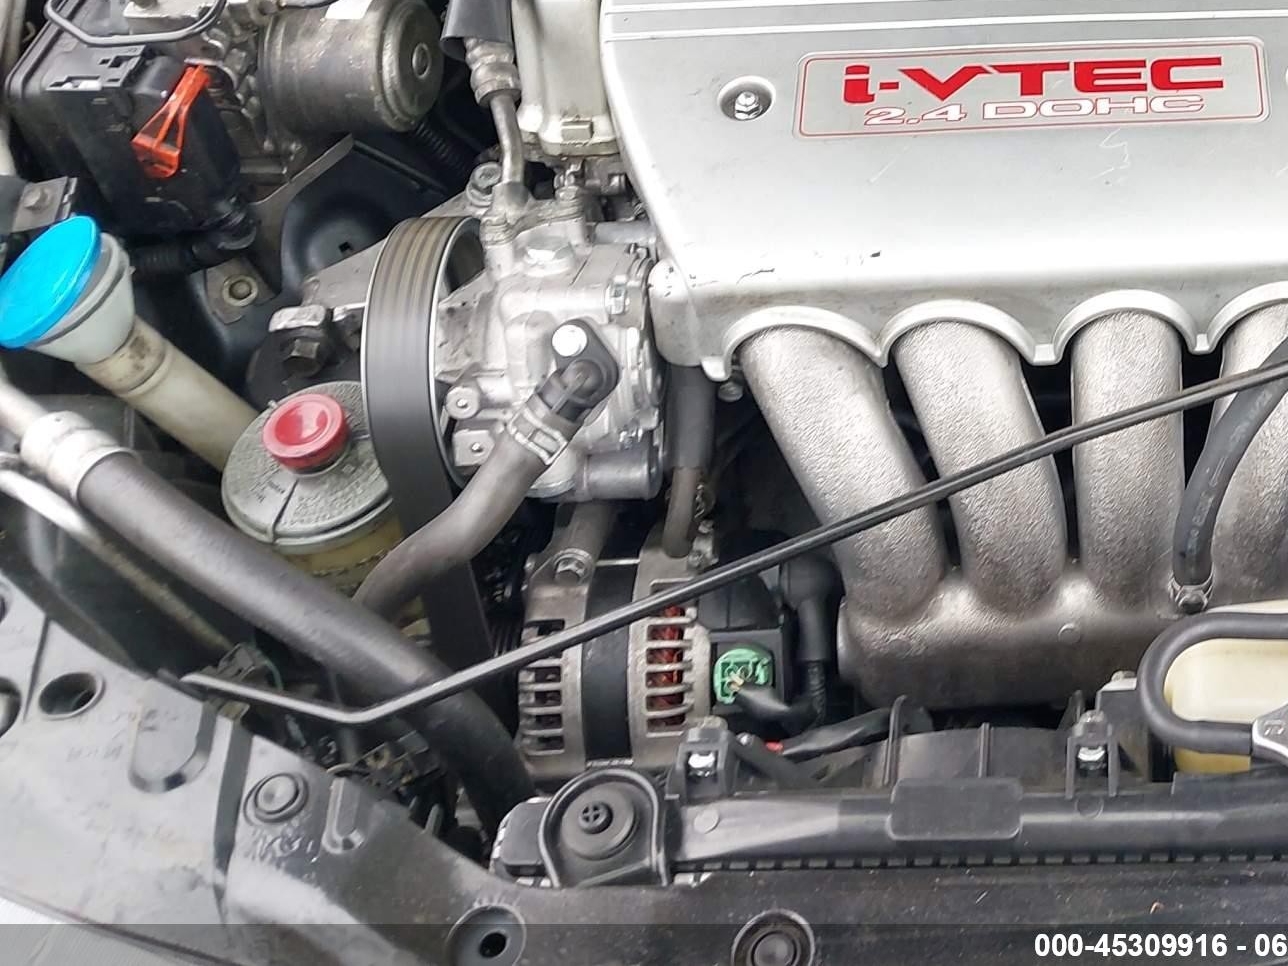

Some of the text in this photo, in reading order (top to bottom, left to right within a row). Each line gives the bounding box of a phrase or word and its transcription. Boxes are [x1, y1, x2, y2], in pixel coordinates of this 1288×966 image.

[843, 57, 1224, 104] i-VTEC
[864, 94, 1204, 126] 2.4 DOHC
